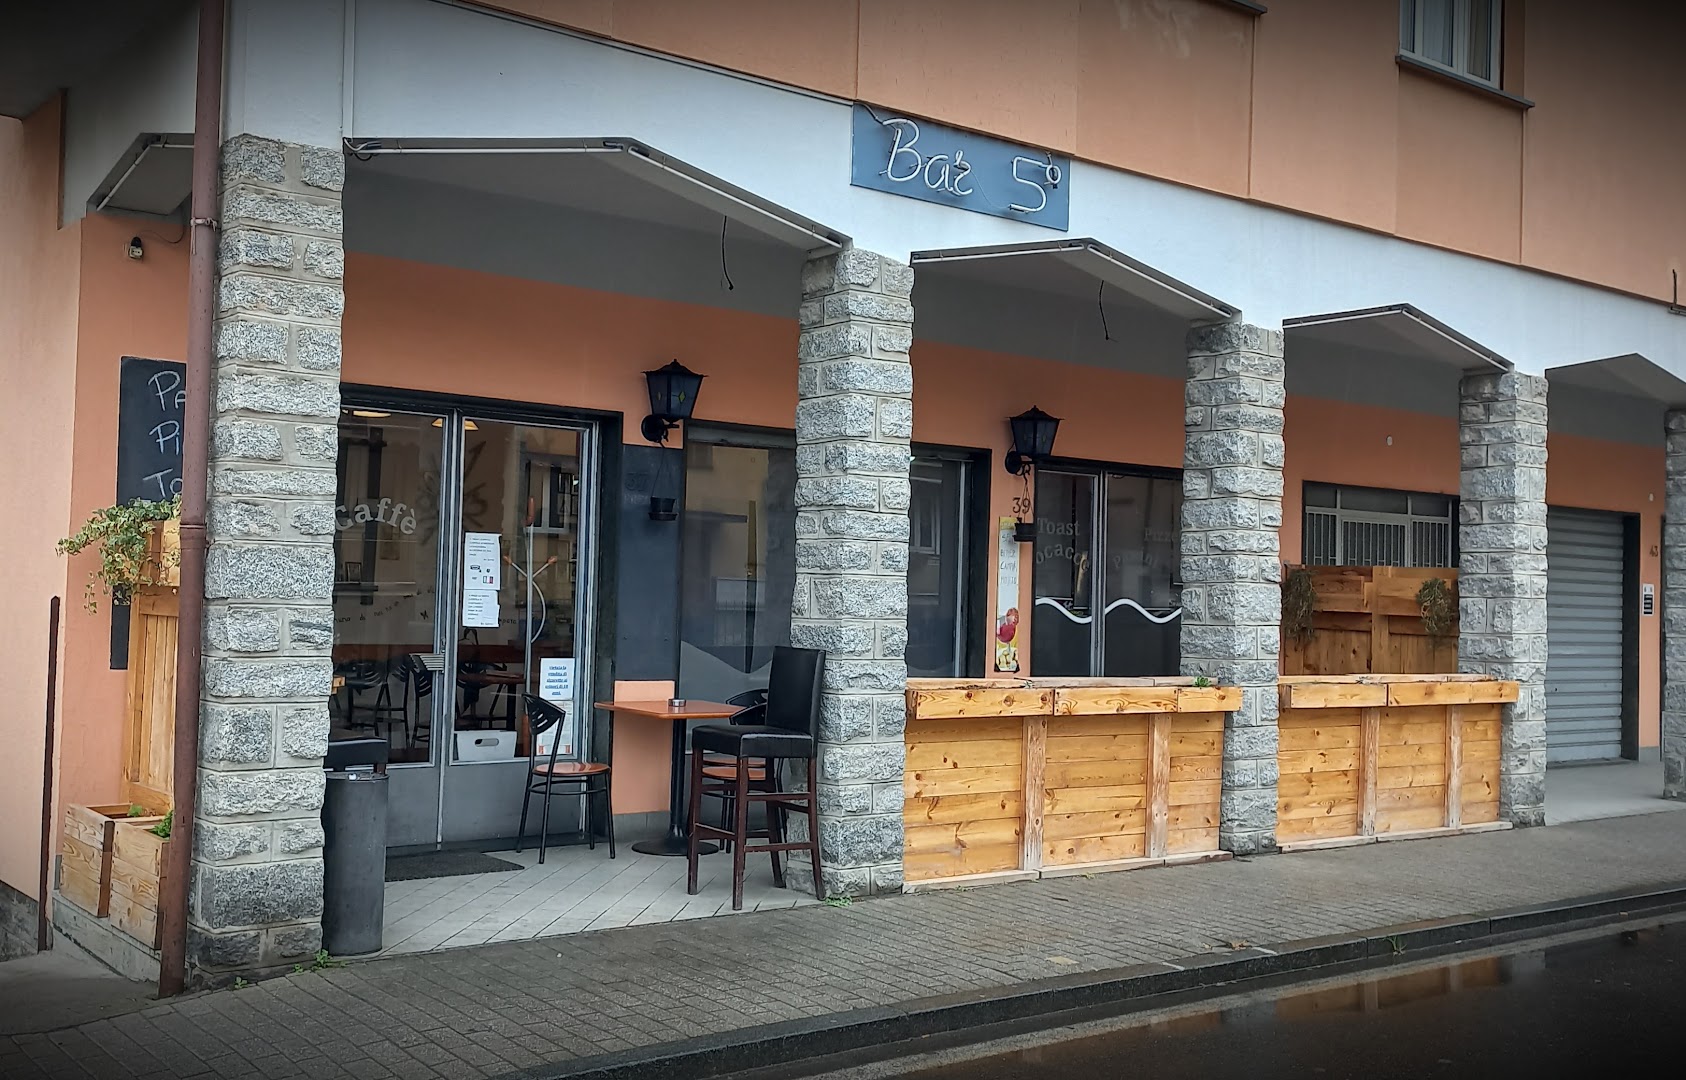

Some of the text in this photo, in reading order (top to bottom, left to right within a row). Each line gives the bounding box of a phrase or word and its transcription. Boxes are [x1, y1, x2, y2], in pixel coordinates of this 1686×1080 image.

[883, 118, 973, 196] Bar
[1012, 497, 1031, 514] 39
[1036, 517, 1081, 536] Toast
